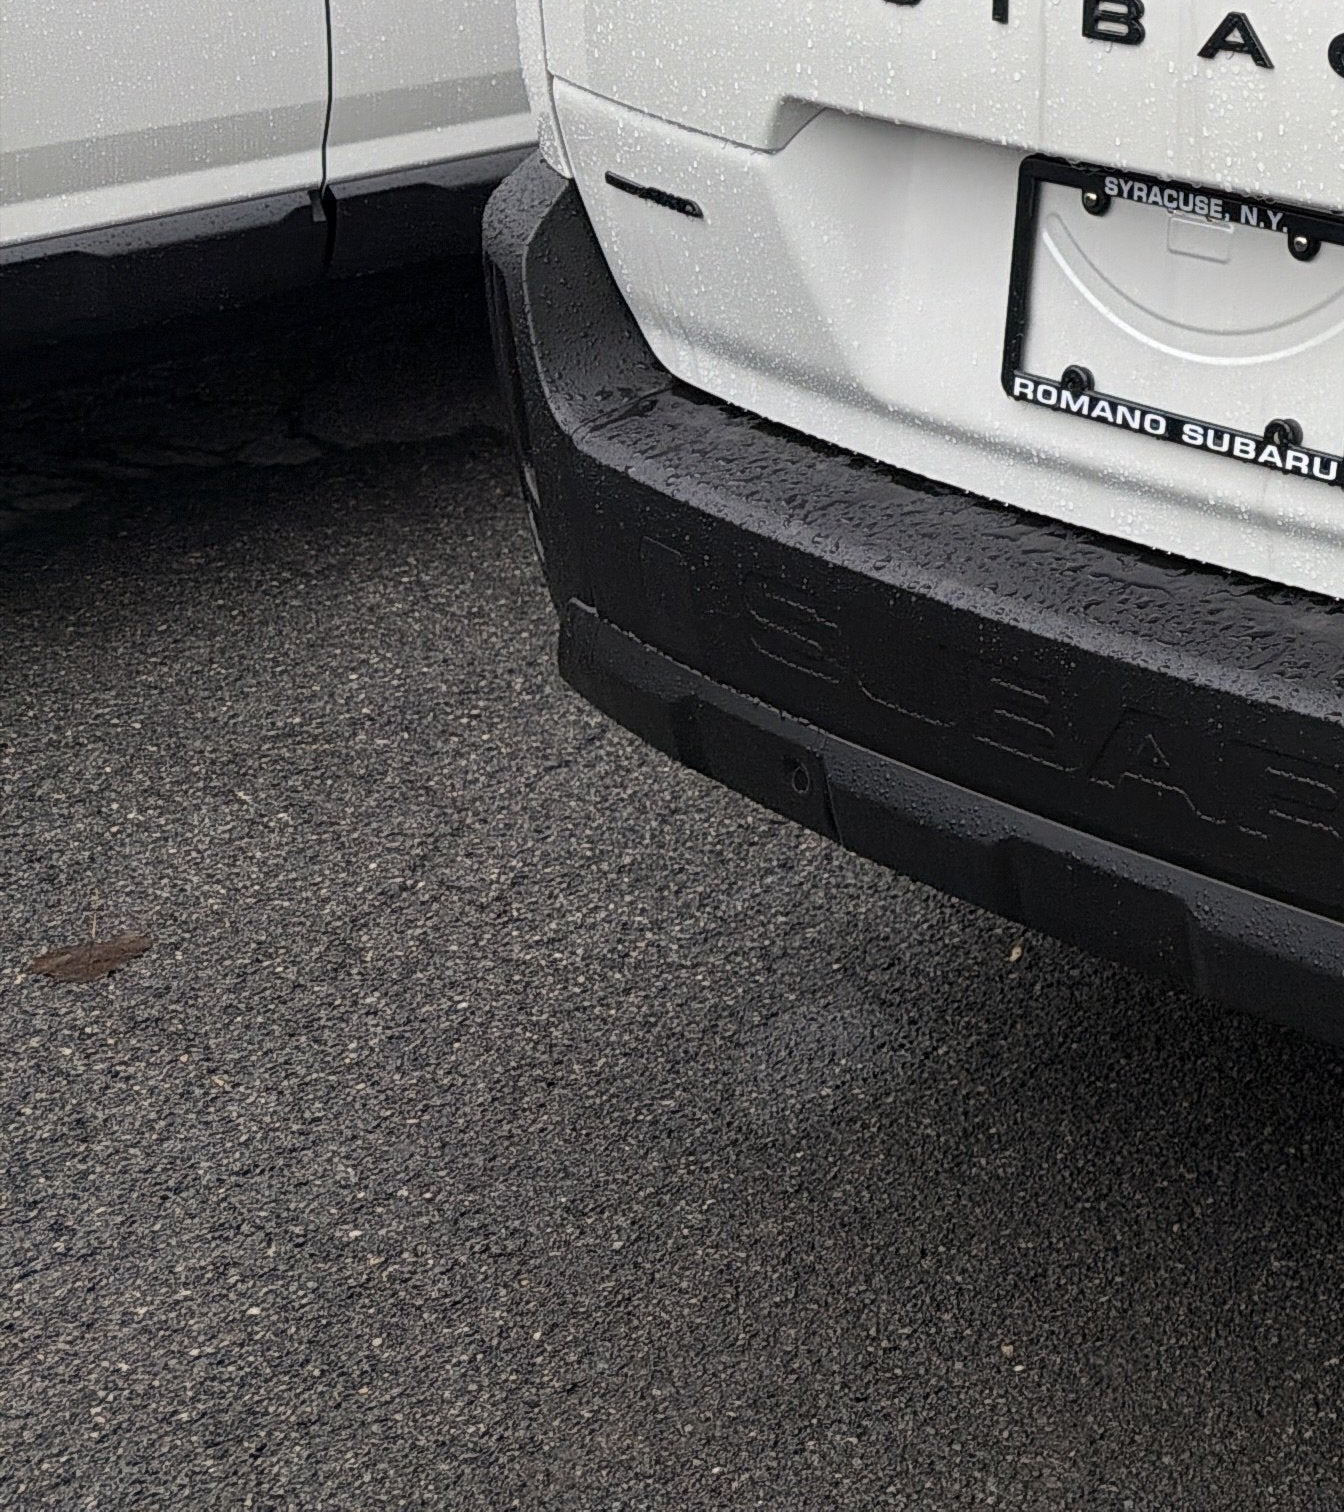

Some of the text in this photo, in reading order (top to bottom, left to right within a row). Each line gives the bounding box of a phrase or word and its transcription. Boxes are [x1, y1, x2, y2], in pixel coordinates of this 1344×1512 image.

[1104, 176, 1288, 233] SYRACUSE, N.Y.
[1013, 376, 1339, 482] ROMANO SUBARU
